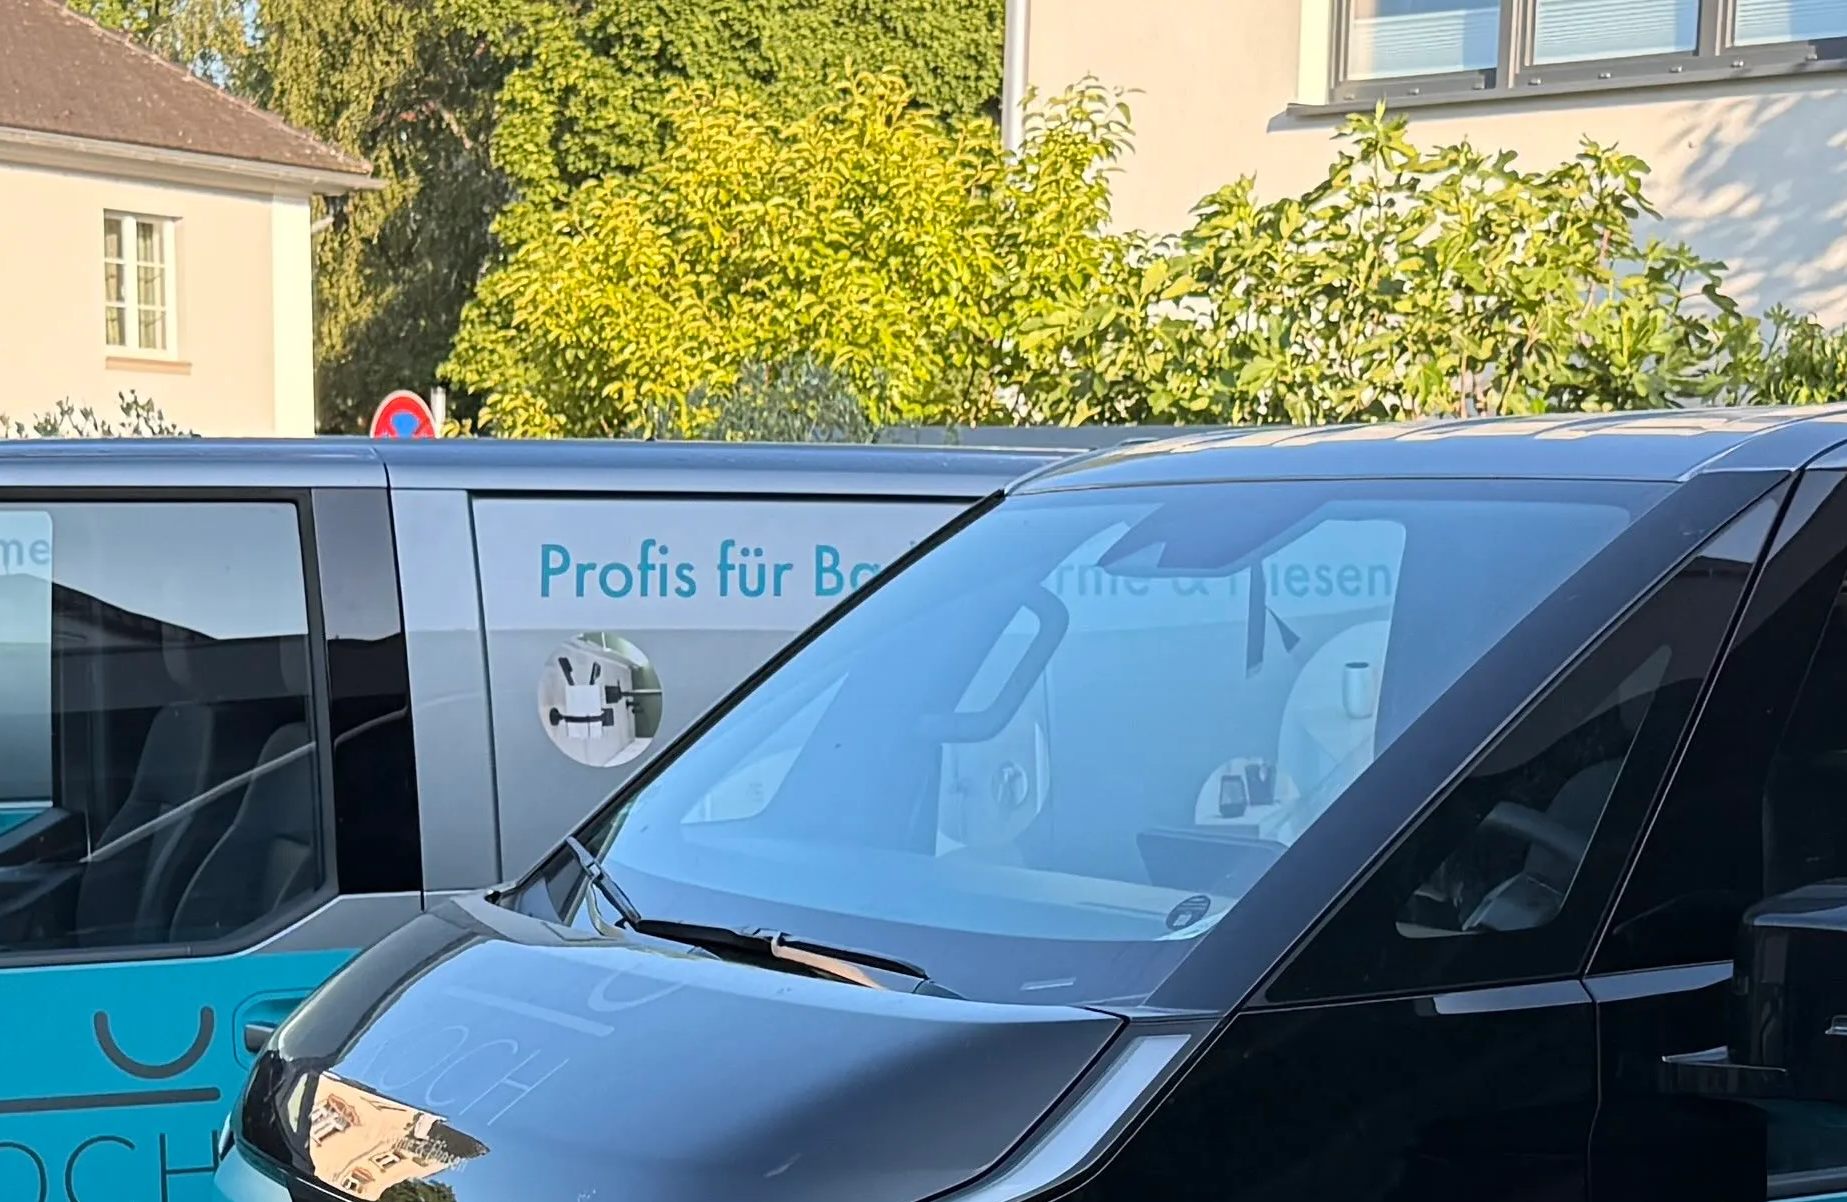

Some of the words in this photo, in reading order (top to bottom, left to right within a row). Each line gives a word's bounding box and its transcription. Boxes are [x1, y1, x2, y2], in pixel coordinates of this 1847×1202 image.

[540, 538, 697, 598] Profis
[717, 538, 794, 597] für
[814, 543, 882, 597] Ba
[361, 1024, 570, 1127] OCH
